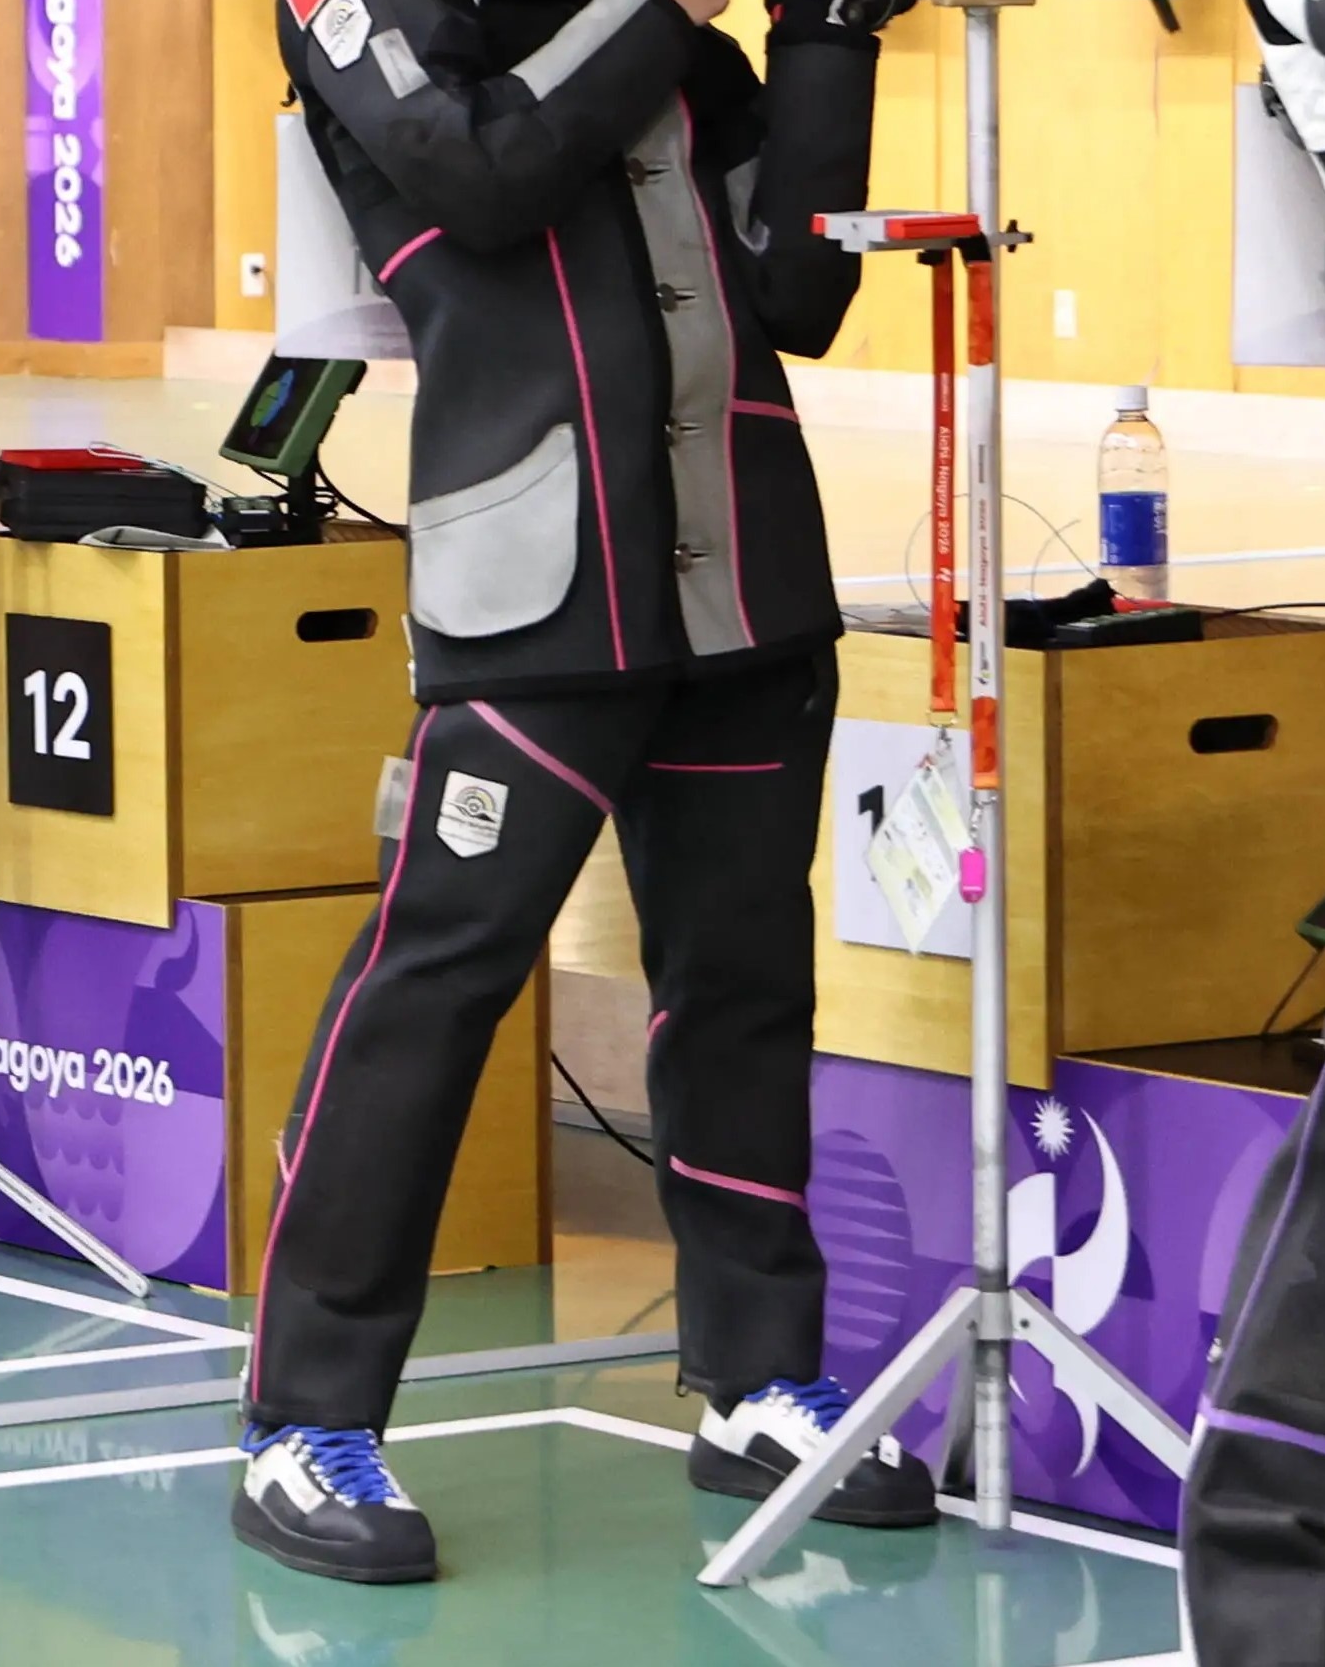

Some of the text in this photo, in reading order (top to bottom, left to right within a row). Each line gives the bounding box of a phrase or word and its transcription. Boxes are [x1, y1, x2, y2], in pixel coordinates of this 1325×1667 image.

[53, 133, 82, 267] 2026
[937, 520, 949, 555] 2026
[23, 669, 91, 760] 12
[93, 1048, 175, 1107] 2026
